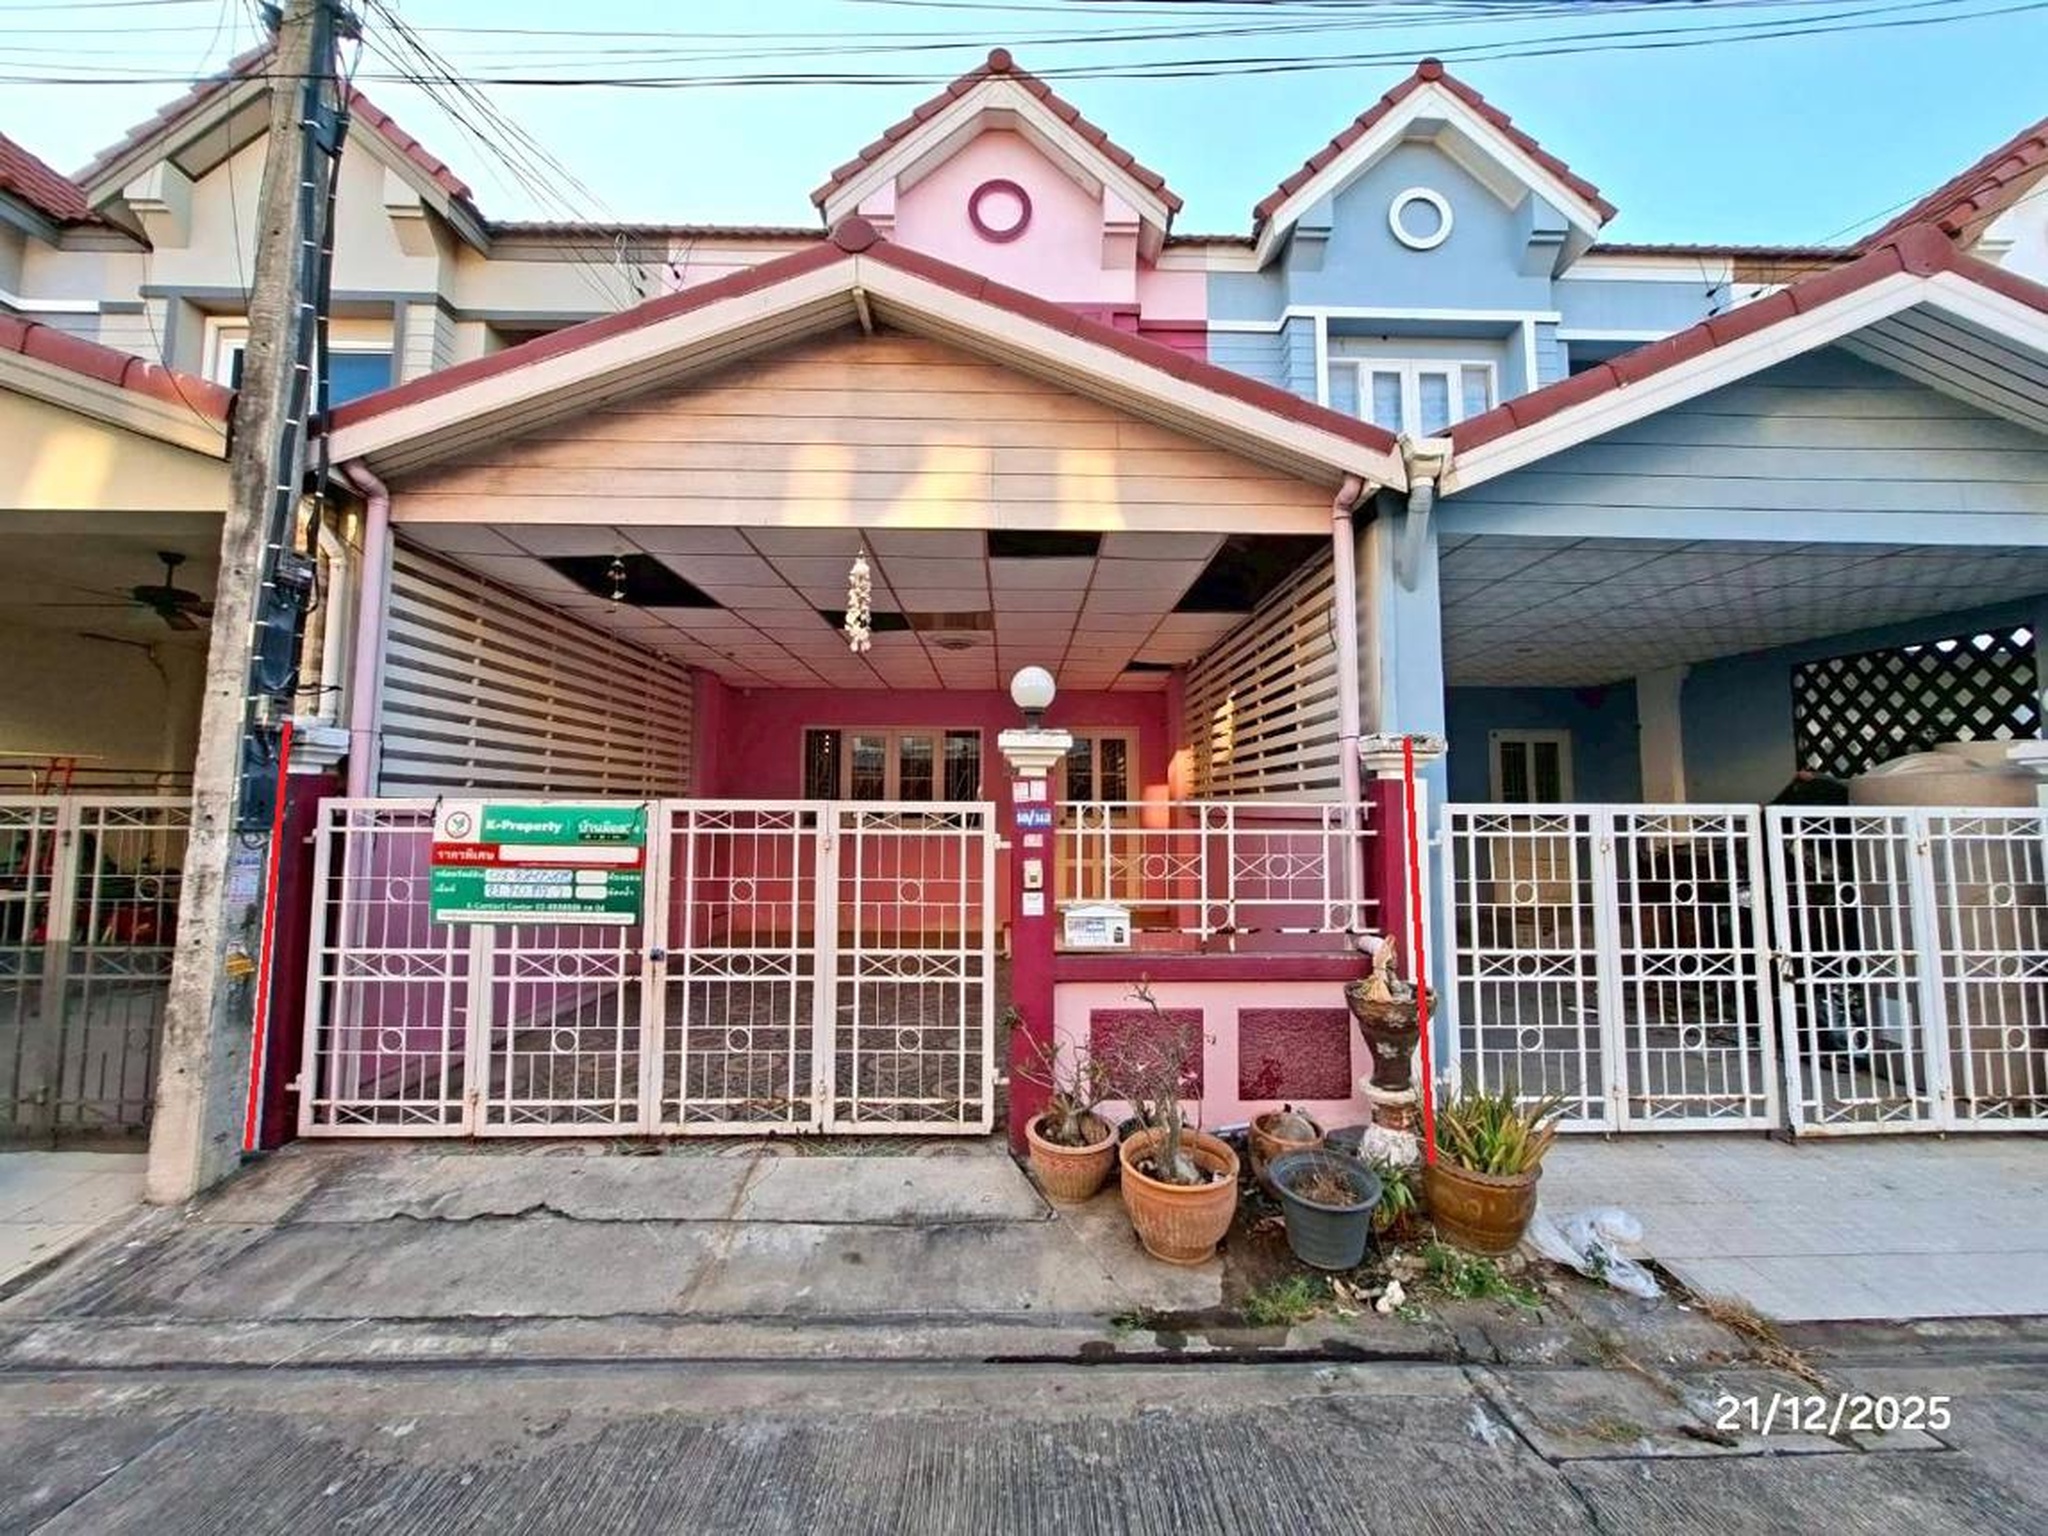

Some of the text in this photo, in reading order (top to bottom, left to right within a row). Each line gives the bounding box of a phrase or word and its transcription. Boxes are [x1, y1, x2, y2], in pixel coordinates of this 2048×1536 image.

[485, 820, 562, 835] K-Property
[437, 847, 495, 860] ราคาพิเศษ
